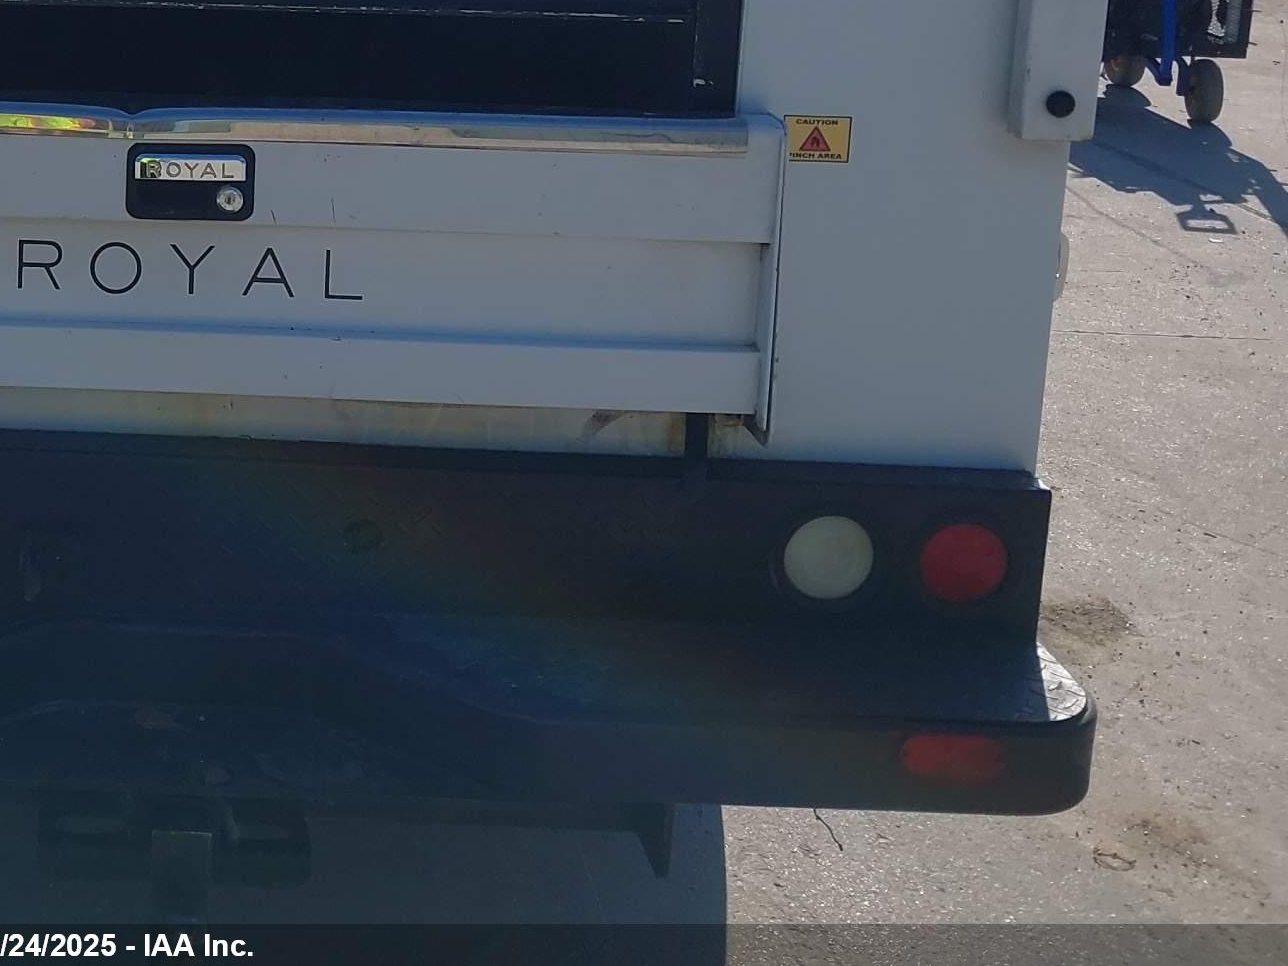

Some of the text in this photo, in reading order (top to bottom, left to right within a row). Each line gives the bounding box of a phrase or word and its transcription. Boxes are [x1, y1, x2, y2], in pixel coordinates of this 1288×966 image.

[795, 118, 839, 126] CAUTION
[140, 159, 235, 179] ROYAL
[17, 239, 363, 300] ROYAL
